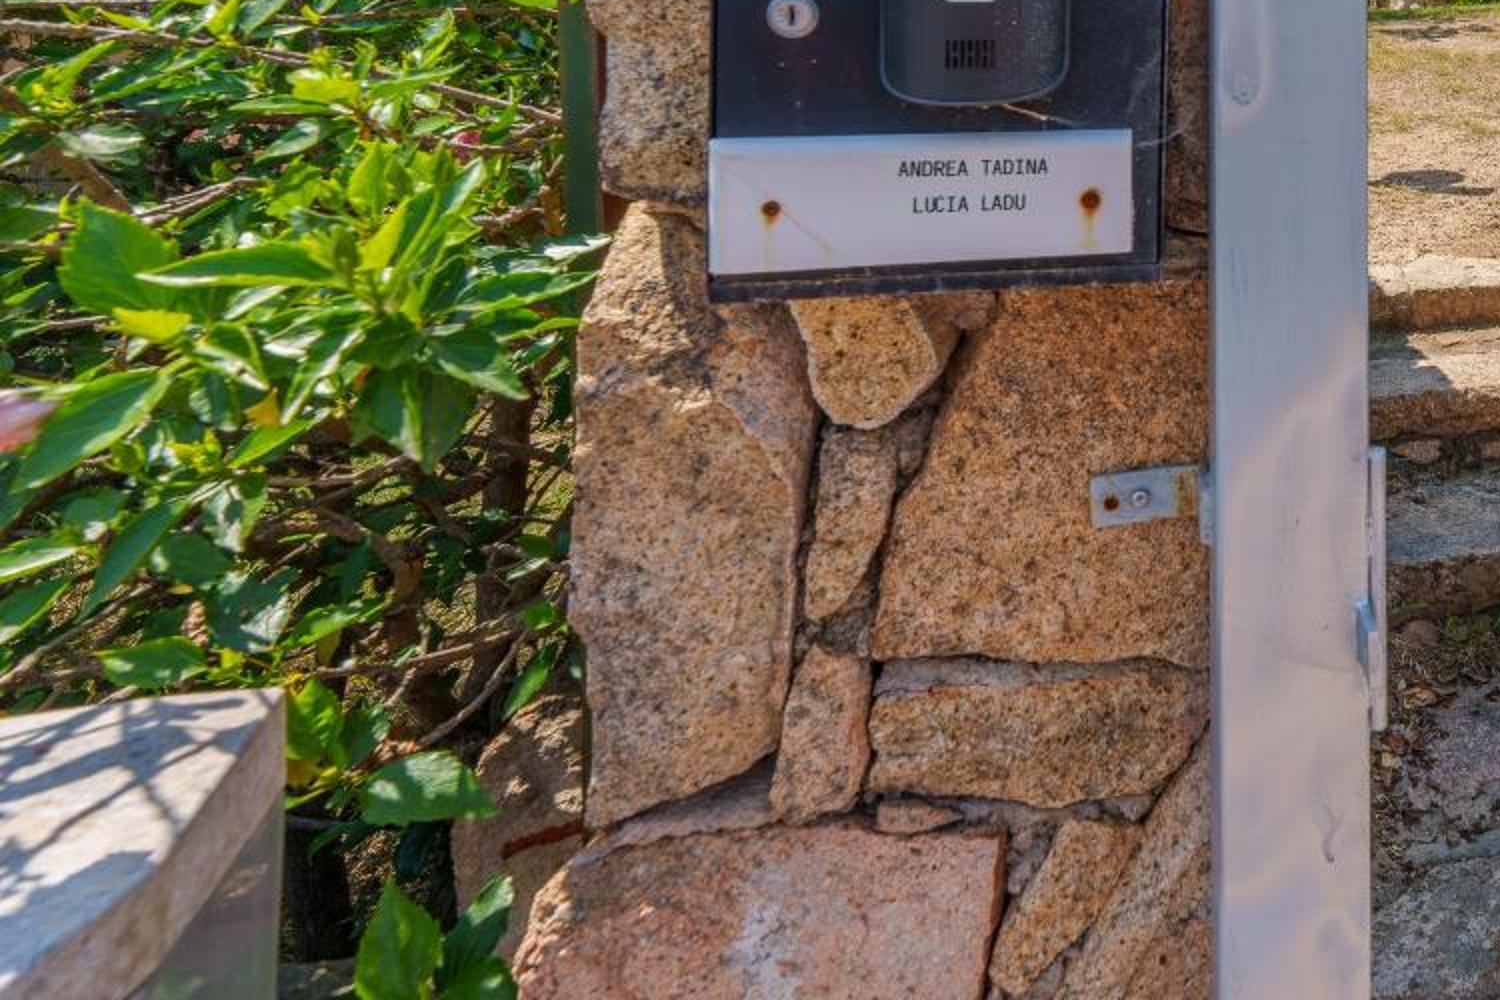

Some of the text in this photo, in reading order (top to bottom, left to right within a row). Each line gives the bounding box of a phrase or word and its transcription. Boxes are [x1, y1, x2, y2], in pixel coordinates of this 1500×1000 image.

[898, 158, 1049, 177] ANDREA TADINA
[912, 194, 1027, 213] LUCIA LADU
